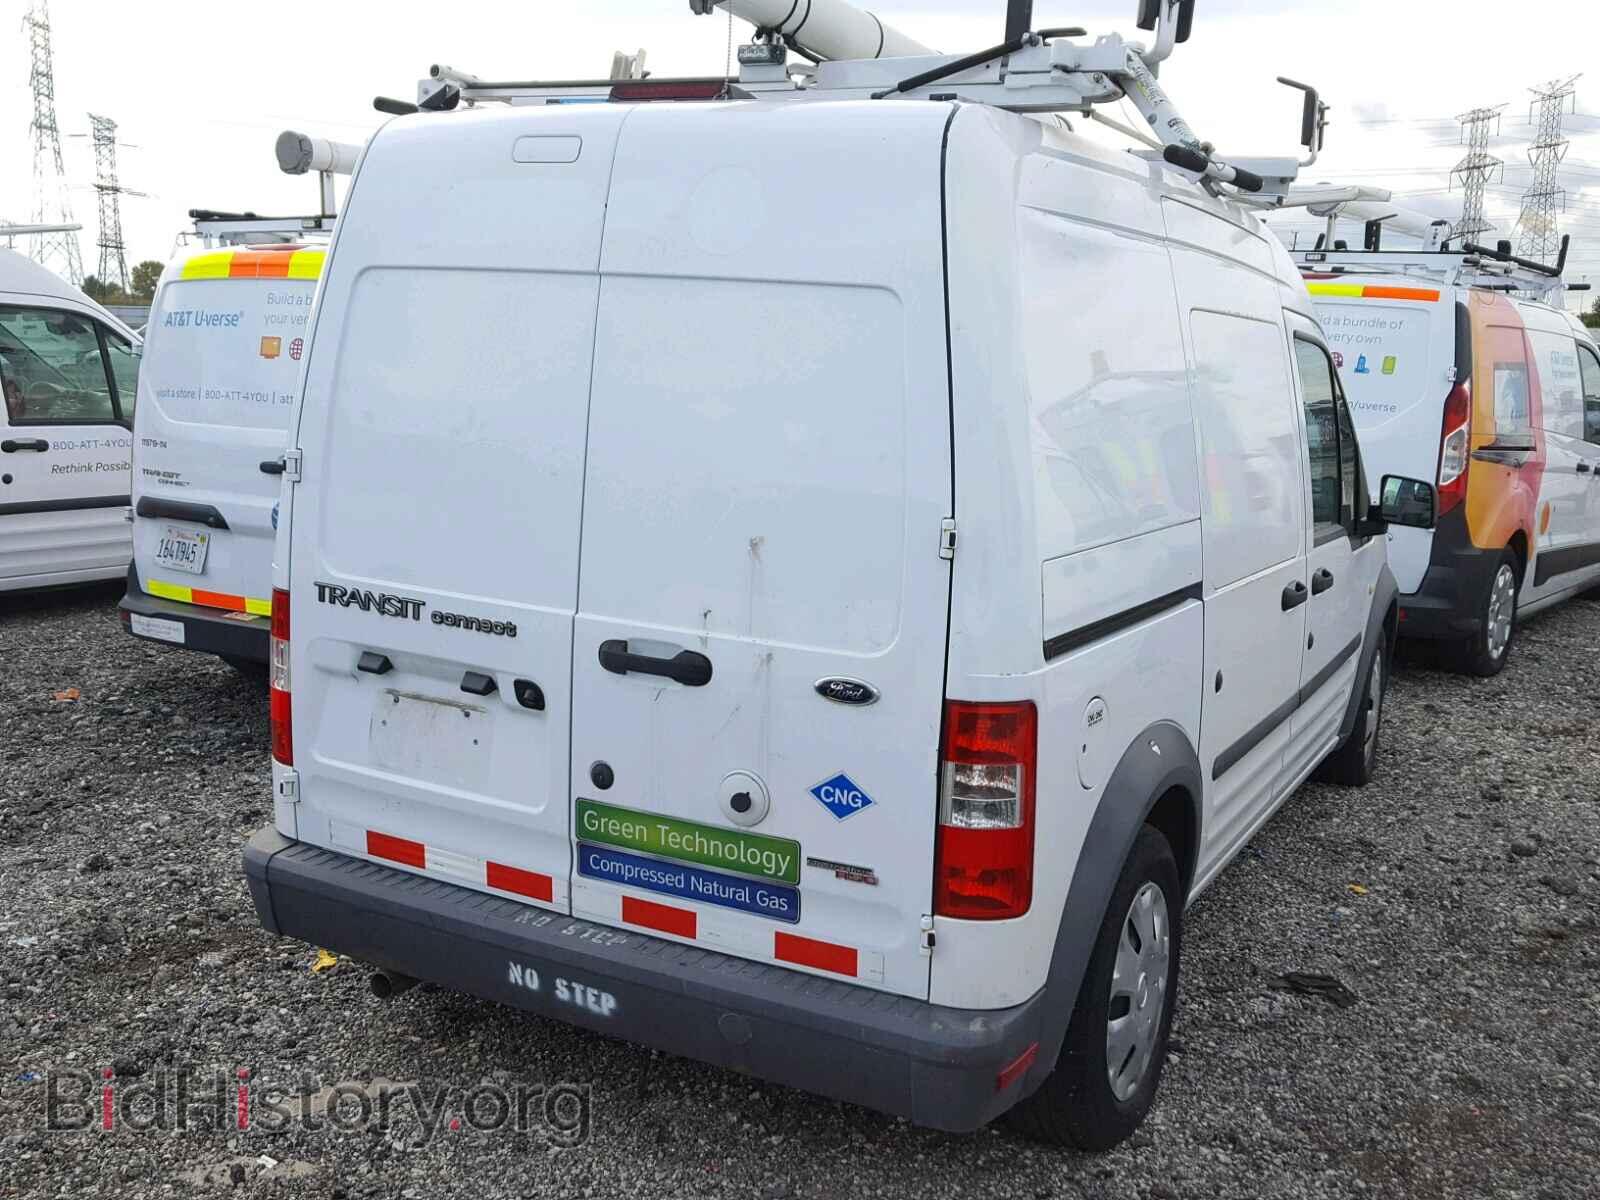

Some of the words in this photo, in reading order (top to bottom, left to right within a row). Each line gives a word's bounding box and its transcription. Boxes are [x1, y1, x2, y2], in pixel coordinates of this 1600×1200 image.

[164, 310, 193, 328] AT&T
[1343, 315, 1387, 329] bundle
[1355, 335, 1383, 345] own
[51, 460, 93, 475] Rethink
[156, 538, 197, 564] 1647945
[314, 581, 425, 622] TRANSIT
[430, 610, 517, 637] connect
[820, 785, 863, 809] CNG
[583, 810, 648, 843] Green
[656, 824, 791, 877] Technology
[589, 854, 685, 890] Compressed
[690, 876, 751, 905] Natural
[756, 890, 789, 912] Gas
[514, 910, 553, 928] NO
[508, 961, 540, 991] NO
[554, 977, 617, 1016] STEP
